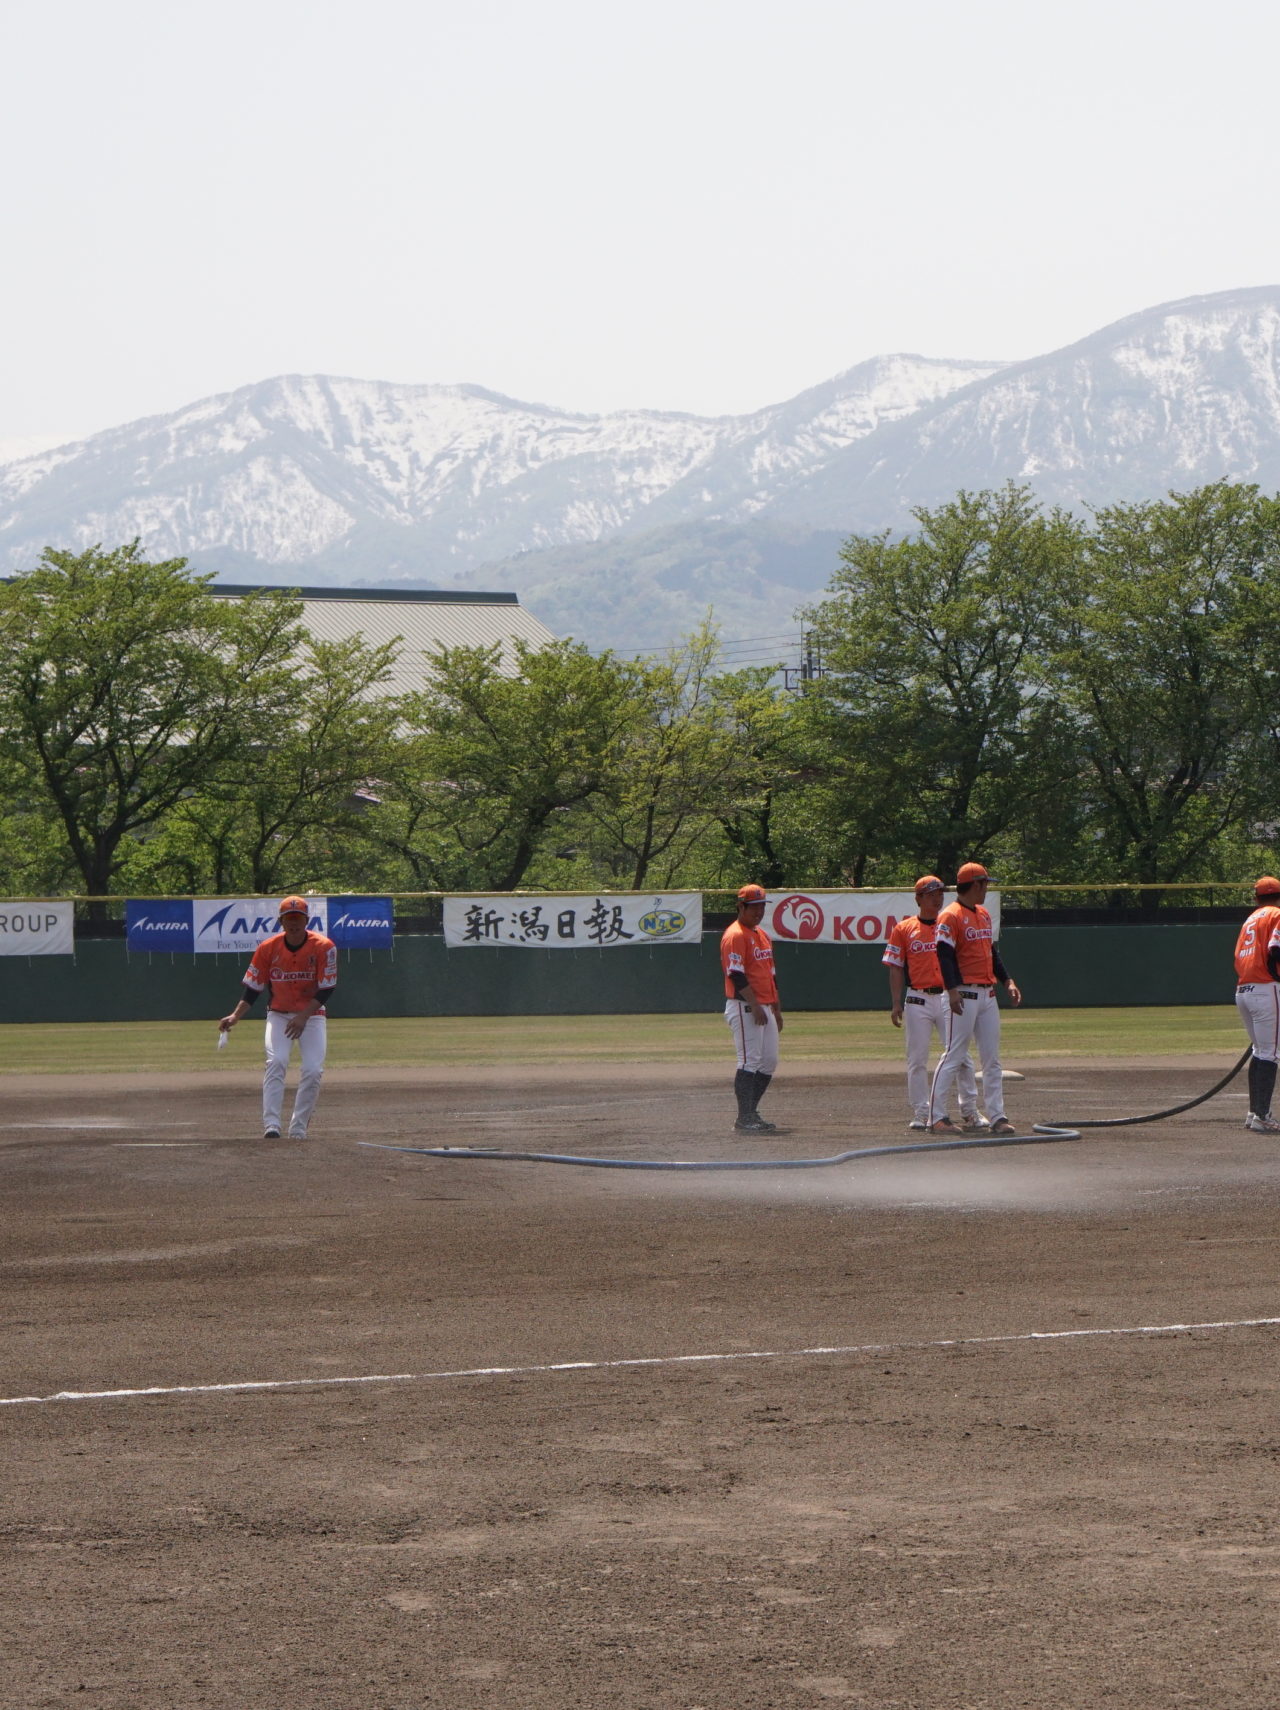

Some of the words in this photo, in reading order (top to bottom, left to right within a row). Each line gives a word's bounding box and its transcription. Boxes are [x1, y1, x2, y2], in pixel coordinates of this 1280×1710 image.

[145, 922, 189, 932] AKIRA
[230, 917, 324, 934] AKIA
[346, 919, 390, 928] AKIRA
[462, 899, 634, 945] 新潟日報
[833, 915, 912, 941] KOM
[1244, 921, 1256, 946] 5
[217, 940, 231, 950] For
[233, 940, 254, 949] Your
